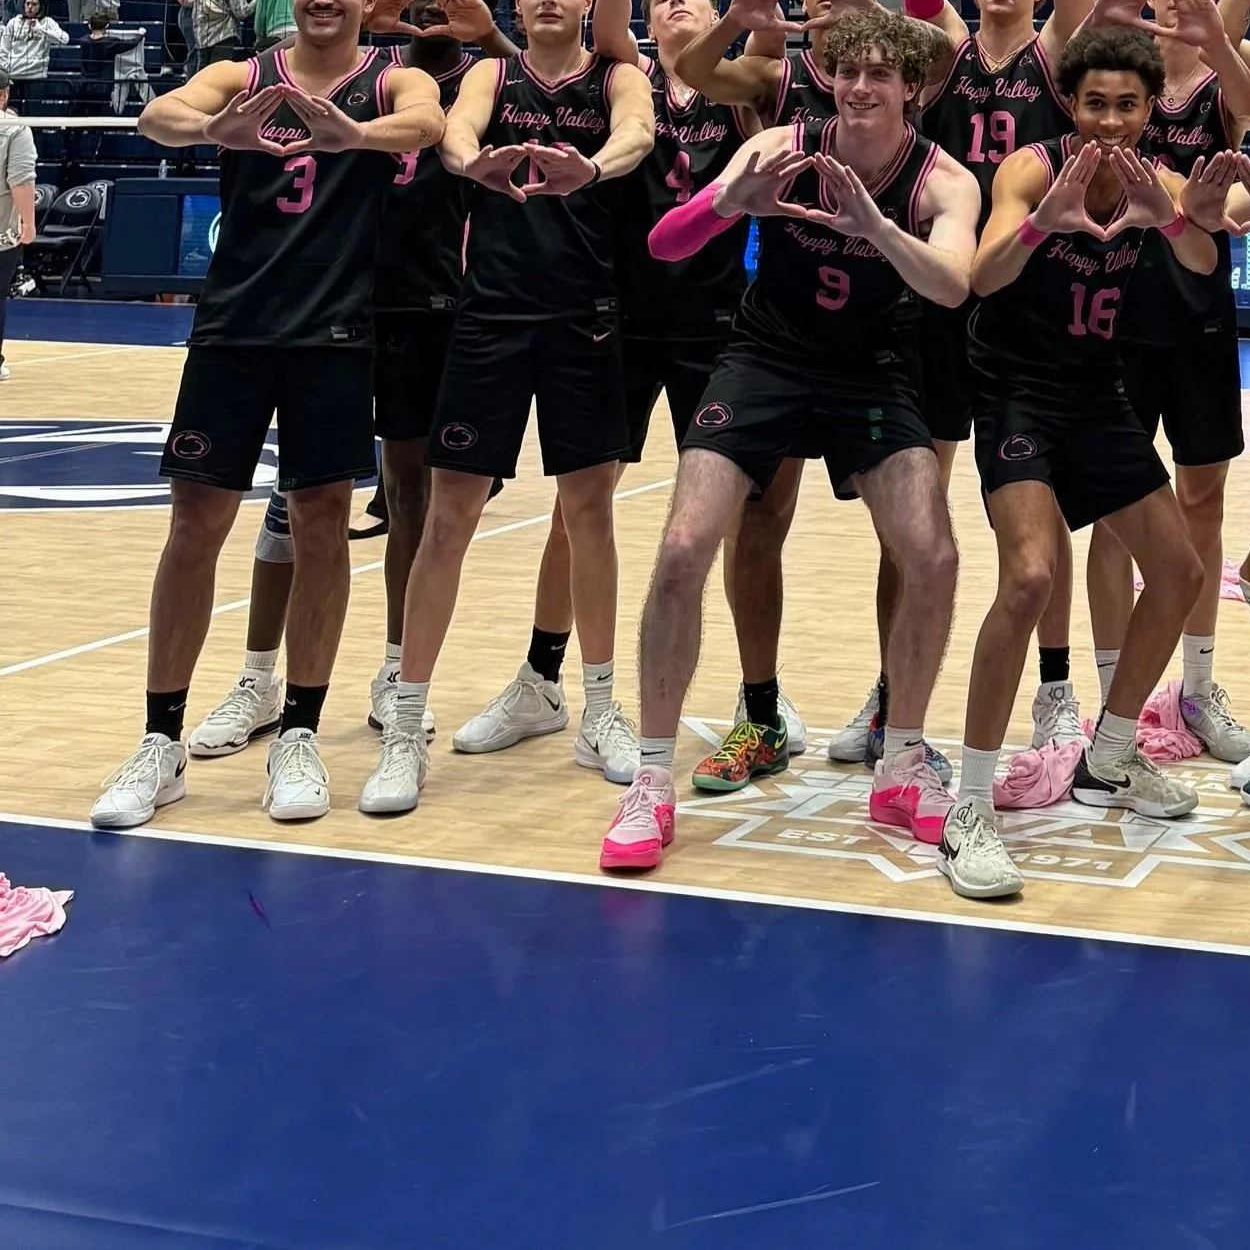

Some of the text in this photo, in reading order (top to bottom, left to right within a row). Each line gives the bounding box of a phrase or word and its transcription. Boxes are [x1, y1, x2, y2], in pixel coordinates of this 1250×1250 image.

[500, 104, 605, 134] Happy Valley
[967, 111, 1015, 163] 19
[276, 155, 317, 214] 3
[665, 151, 694, 202] 4
[815, 265, 850, 311] 9
[1068, 283, 1121, 340] 16
[777, 828, 872, 844] EST
[1011, 853, 1113, 870] 1971
